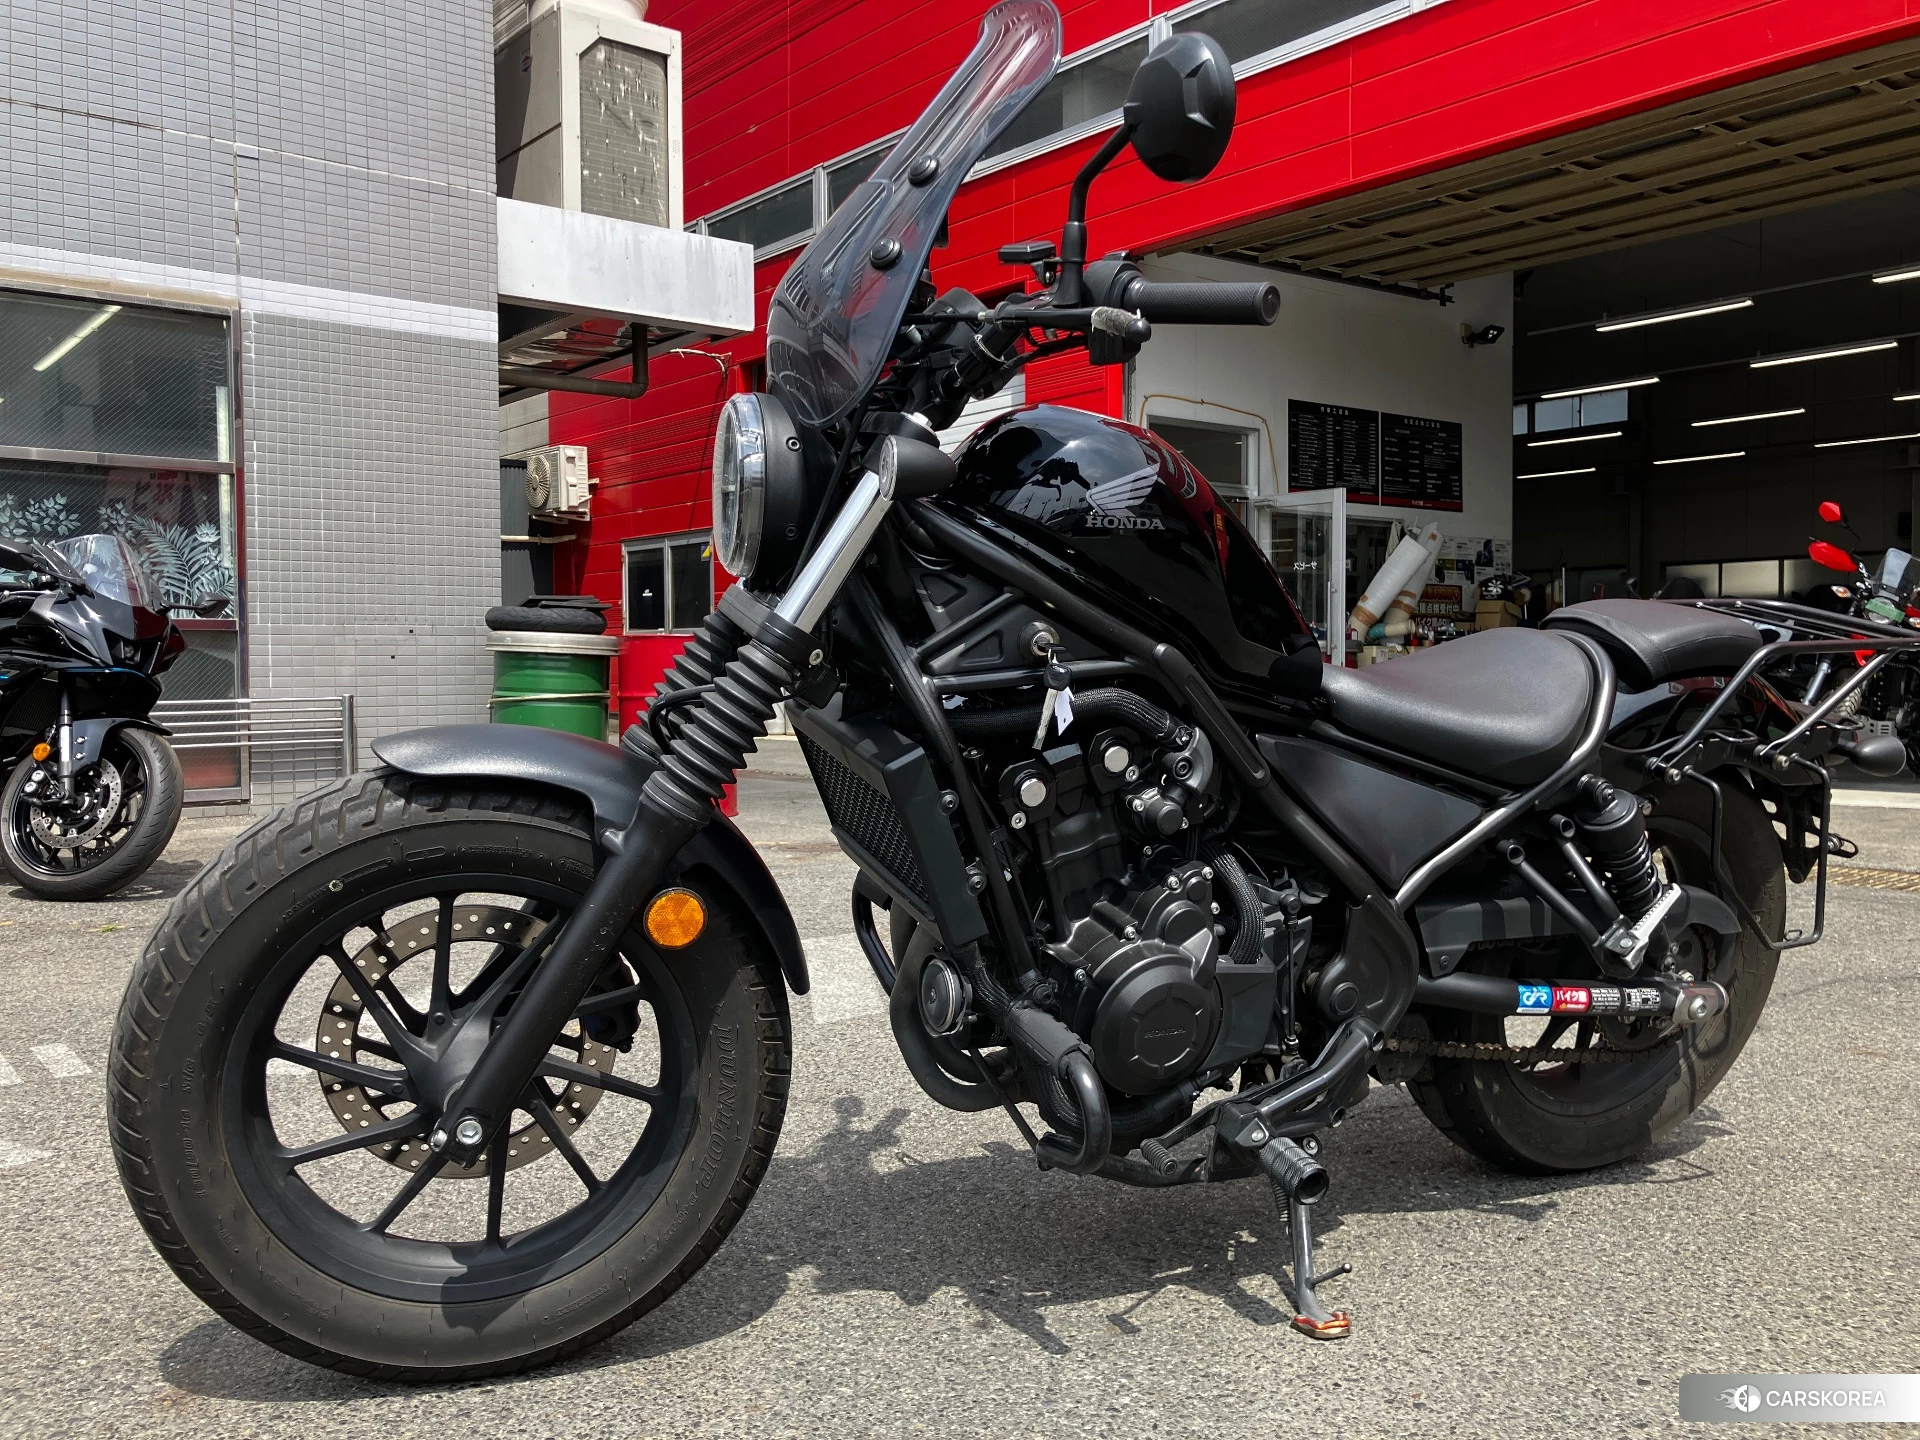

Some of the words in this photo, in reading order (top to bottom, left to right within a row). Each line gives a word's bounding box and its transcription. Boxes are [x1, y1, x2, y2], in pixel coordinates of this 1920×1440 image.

[1085, 515, 1165, 530] HONDA
[1556, 990, 1587, 1003] バイク館
[1143, 1029, 1187, 1040] HONDA
[698, 1024, 737, 1190] DUNLOP
